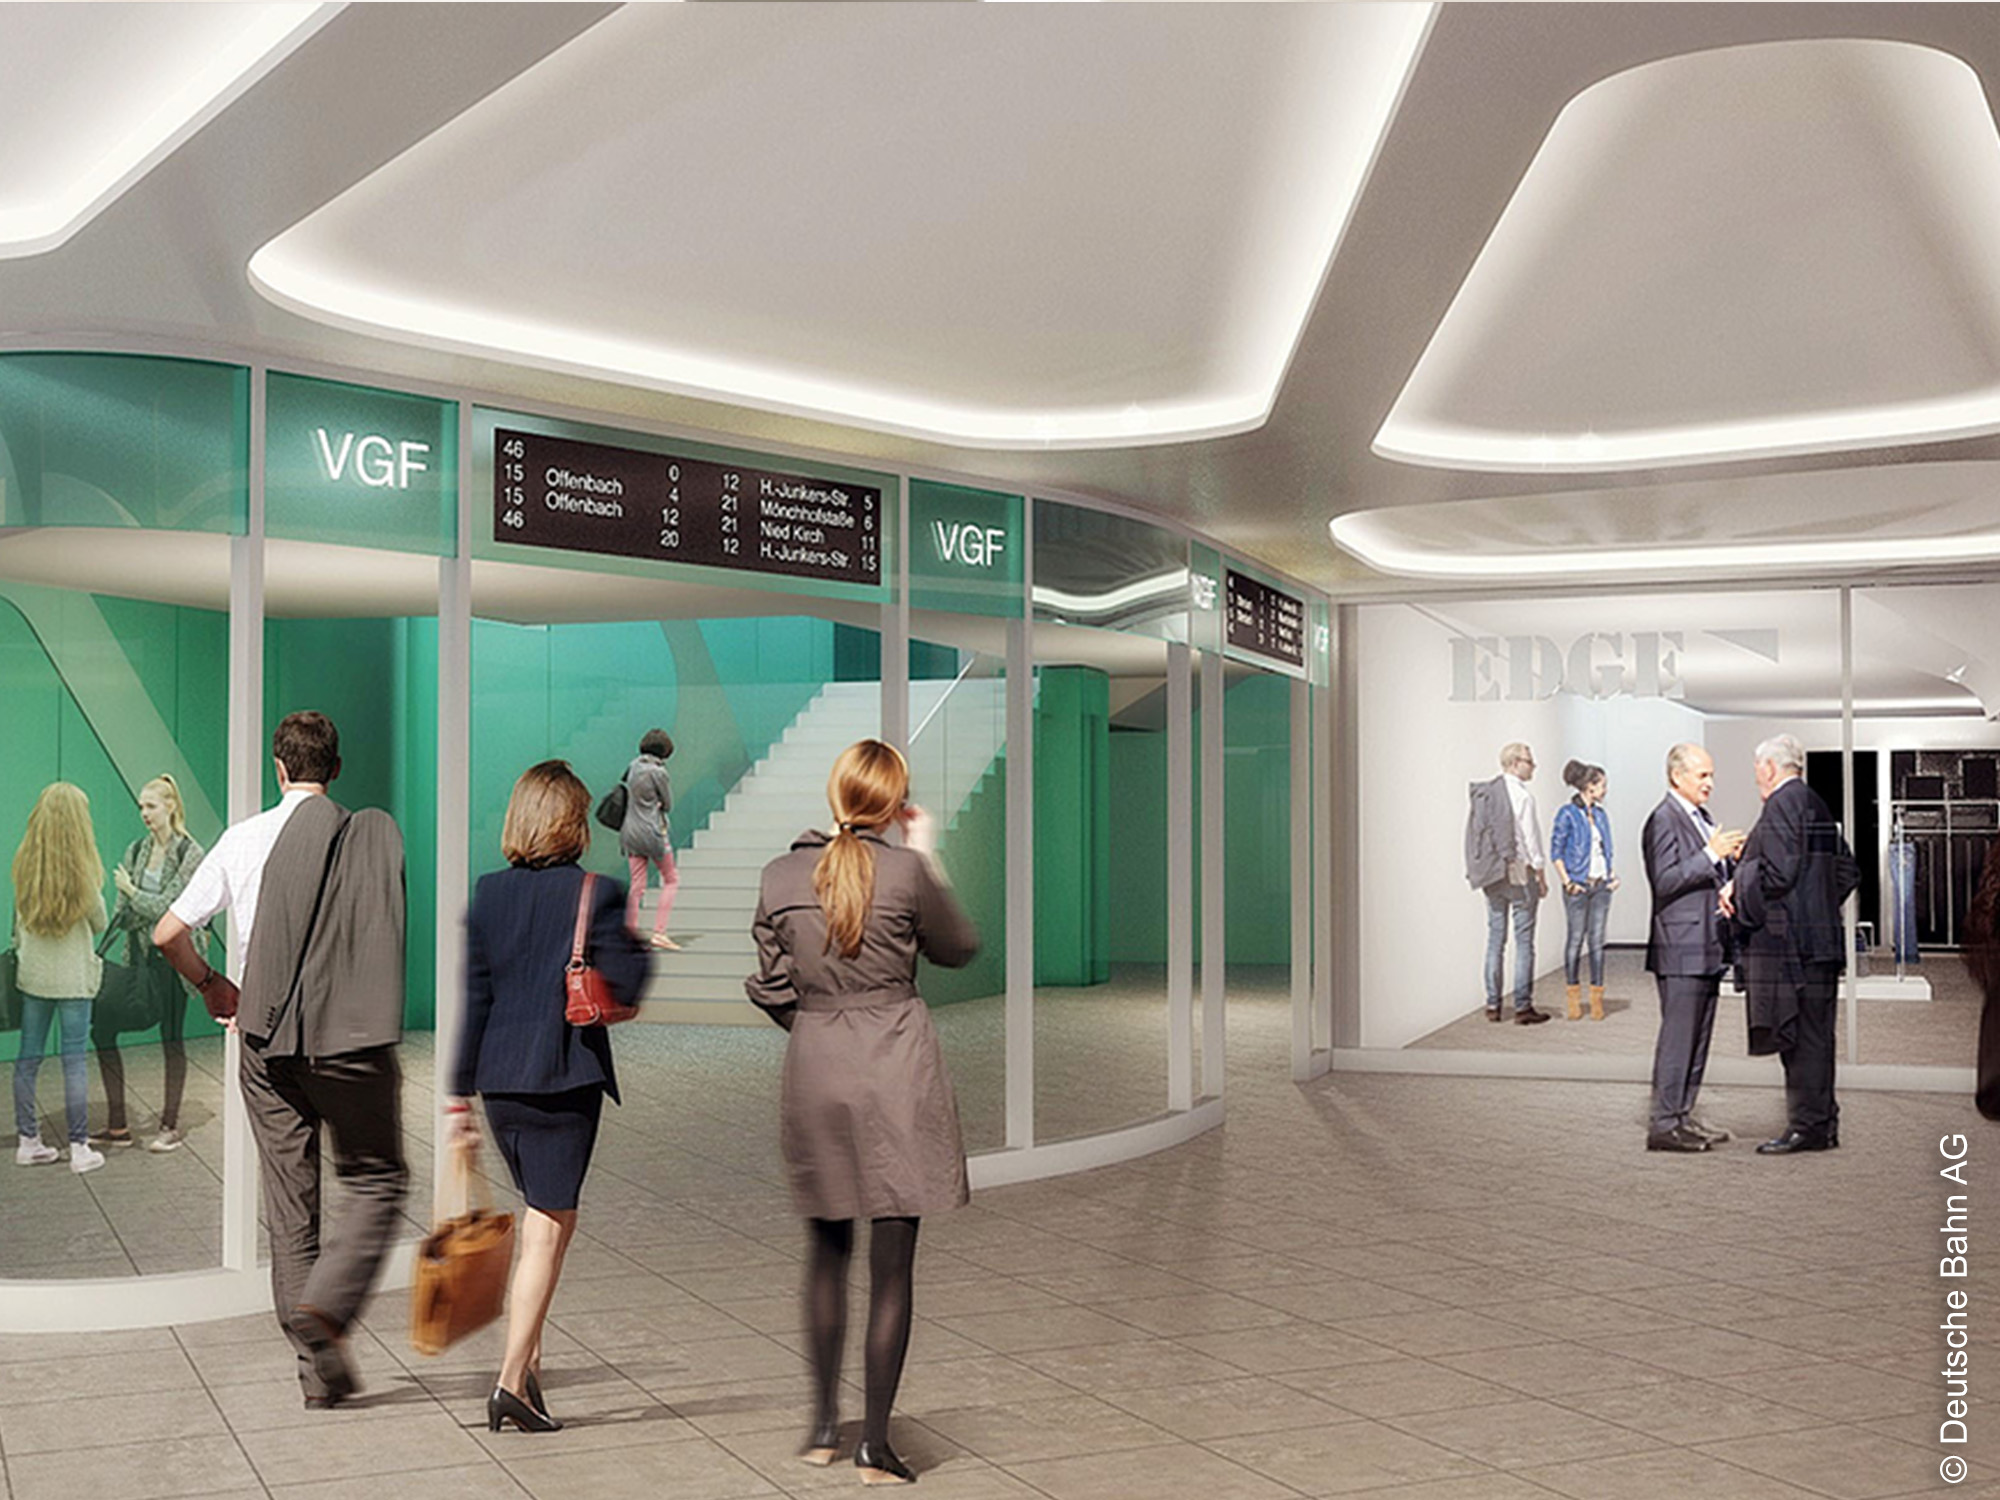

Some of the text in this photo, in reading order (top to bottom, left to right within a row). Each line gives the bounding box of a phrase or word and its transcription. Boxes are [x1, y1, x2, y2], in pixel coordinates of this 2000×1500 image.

[316, 428, 430, 489] VGF
[502, 439, 680, 482] 46 0
[504, 463, 680, 503] 15 Offenbach 4
[722, 474, 740, 491] 12
[863, 495, 873, 510] 5
[504, 486, 680, 526] 15 Offenbach 12
[721, 494, 738, 511] 21
[863, 515, 873, 531] 6
[502, 509, 680, 548] 46 20
[721, 515, 738, 533] 21
[861, 535, 876, 550] 11
[936, 520, 1005, 567] VGF
[722, 537, 740, 554] 12
[861, 554, 877, 572] 15
[1448, 631, 1685, 701] EDGE
